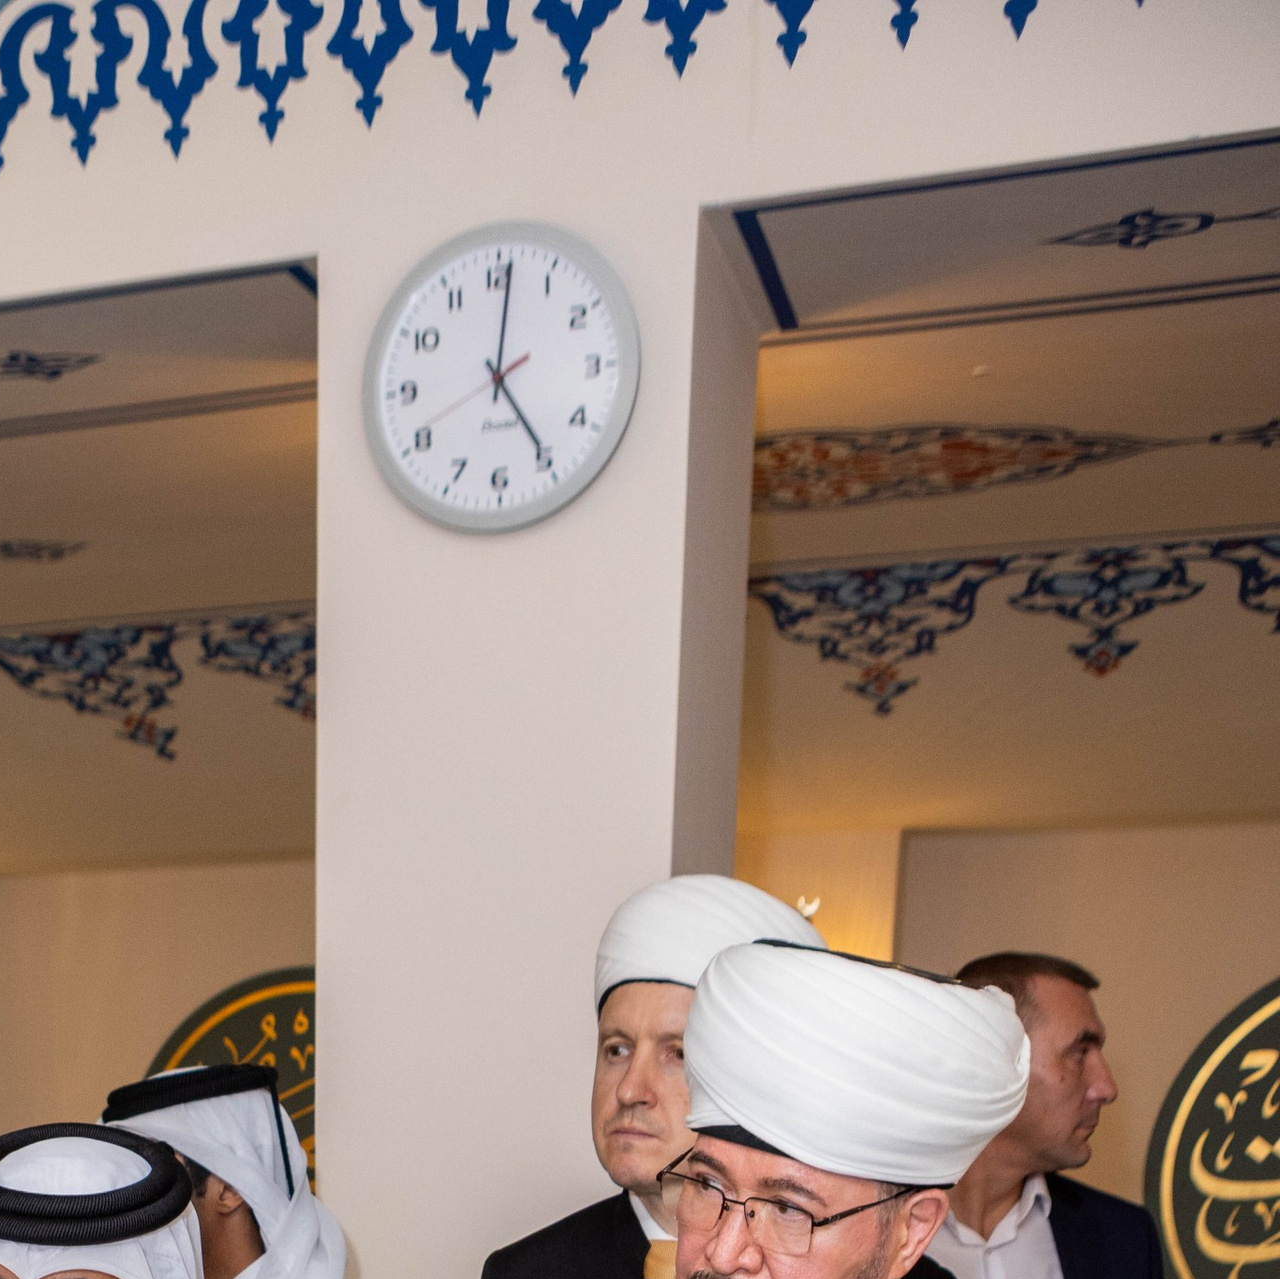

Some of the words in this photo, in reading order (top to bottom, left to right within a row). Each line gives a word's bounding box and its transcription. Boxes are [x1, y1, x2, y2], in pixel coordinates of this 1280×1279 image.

[486, 262, 510, 290] 12
[448, 286, 463, 312] 11
[569, 304, 588, 331] 2
[414, 327, 440, 353] 10
[585, 353, 601, 379] 3
[399, 380, 419, 406] 9
[568, 404, 587, 427] 4
[413, 426, 432, 453] 8
[451, 457, 468, 483] 7
[535, 446, 553, 472] 5
[490, 467, 509, 491] 6
